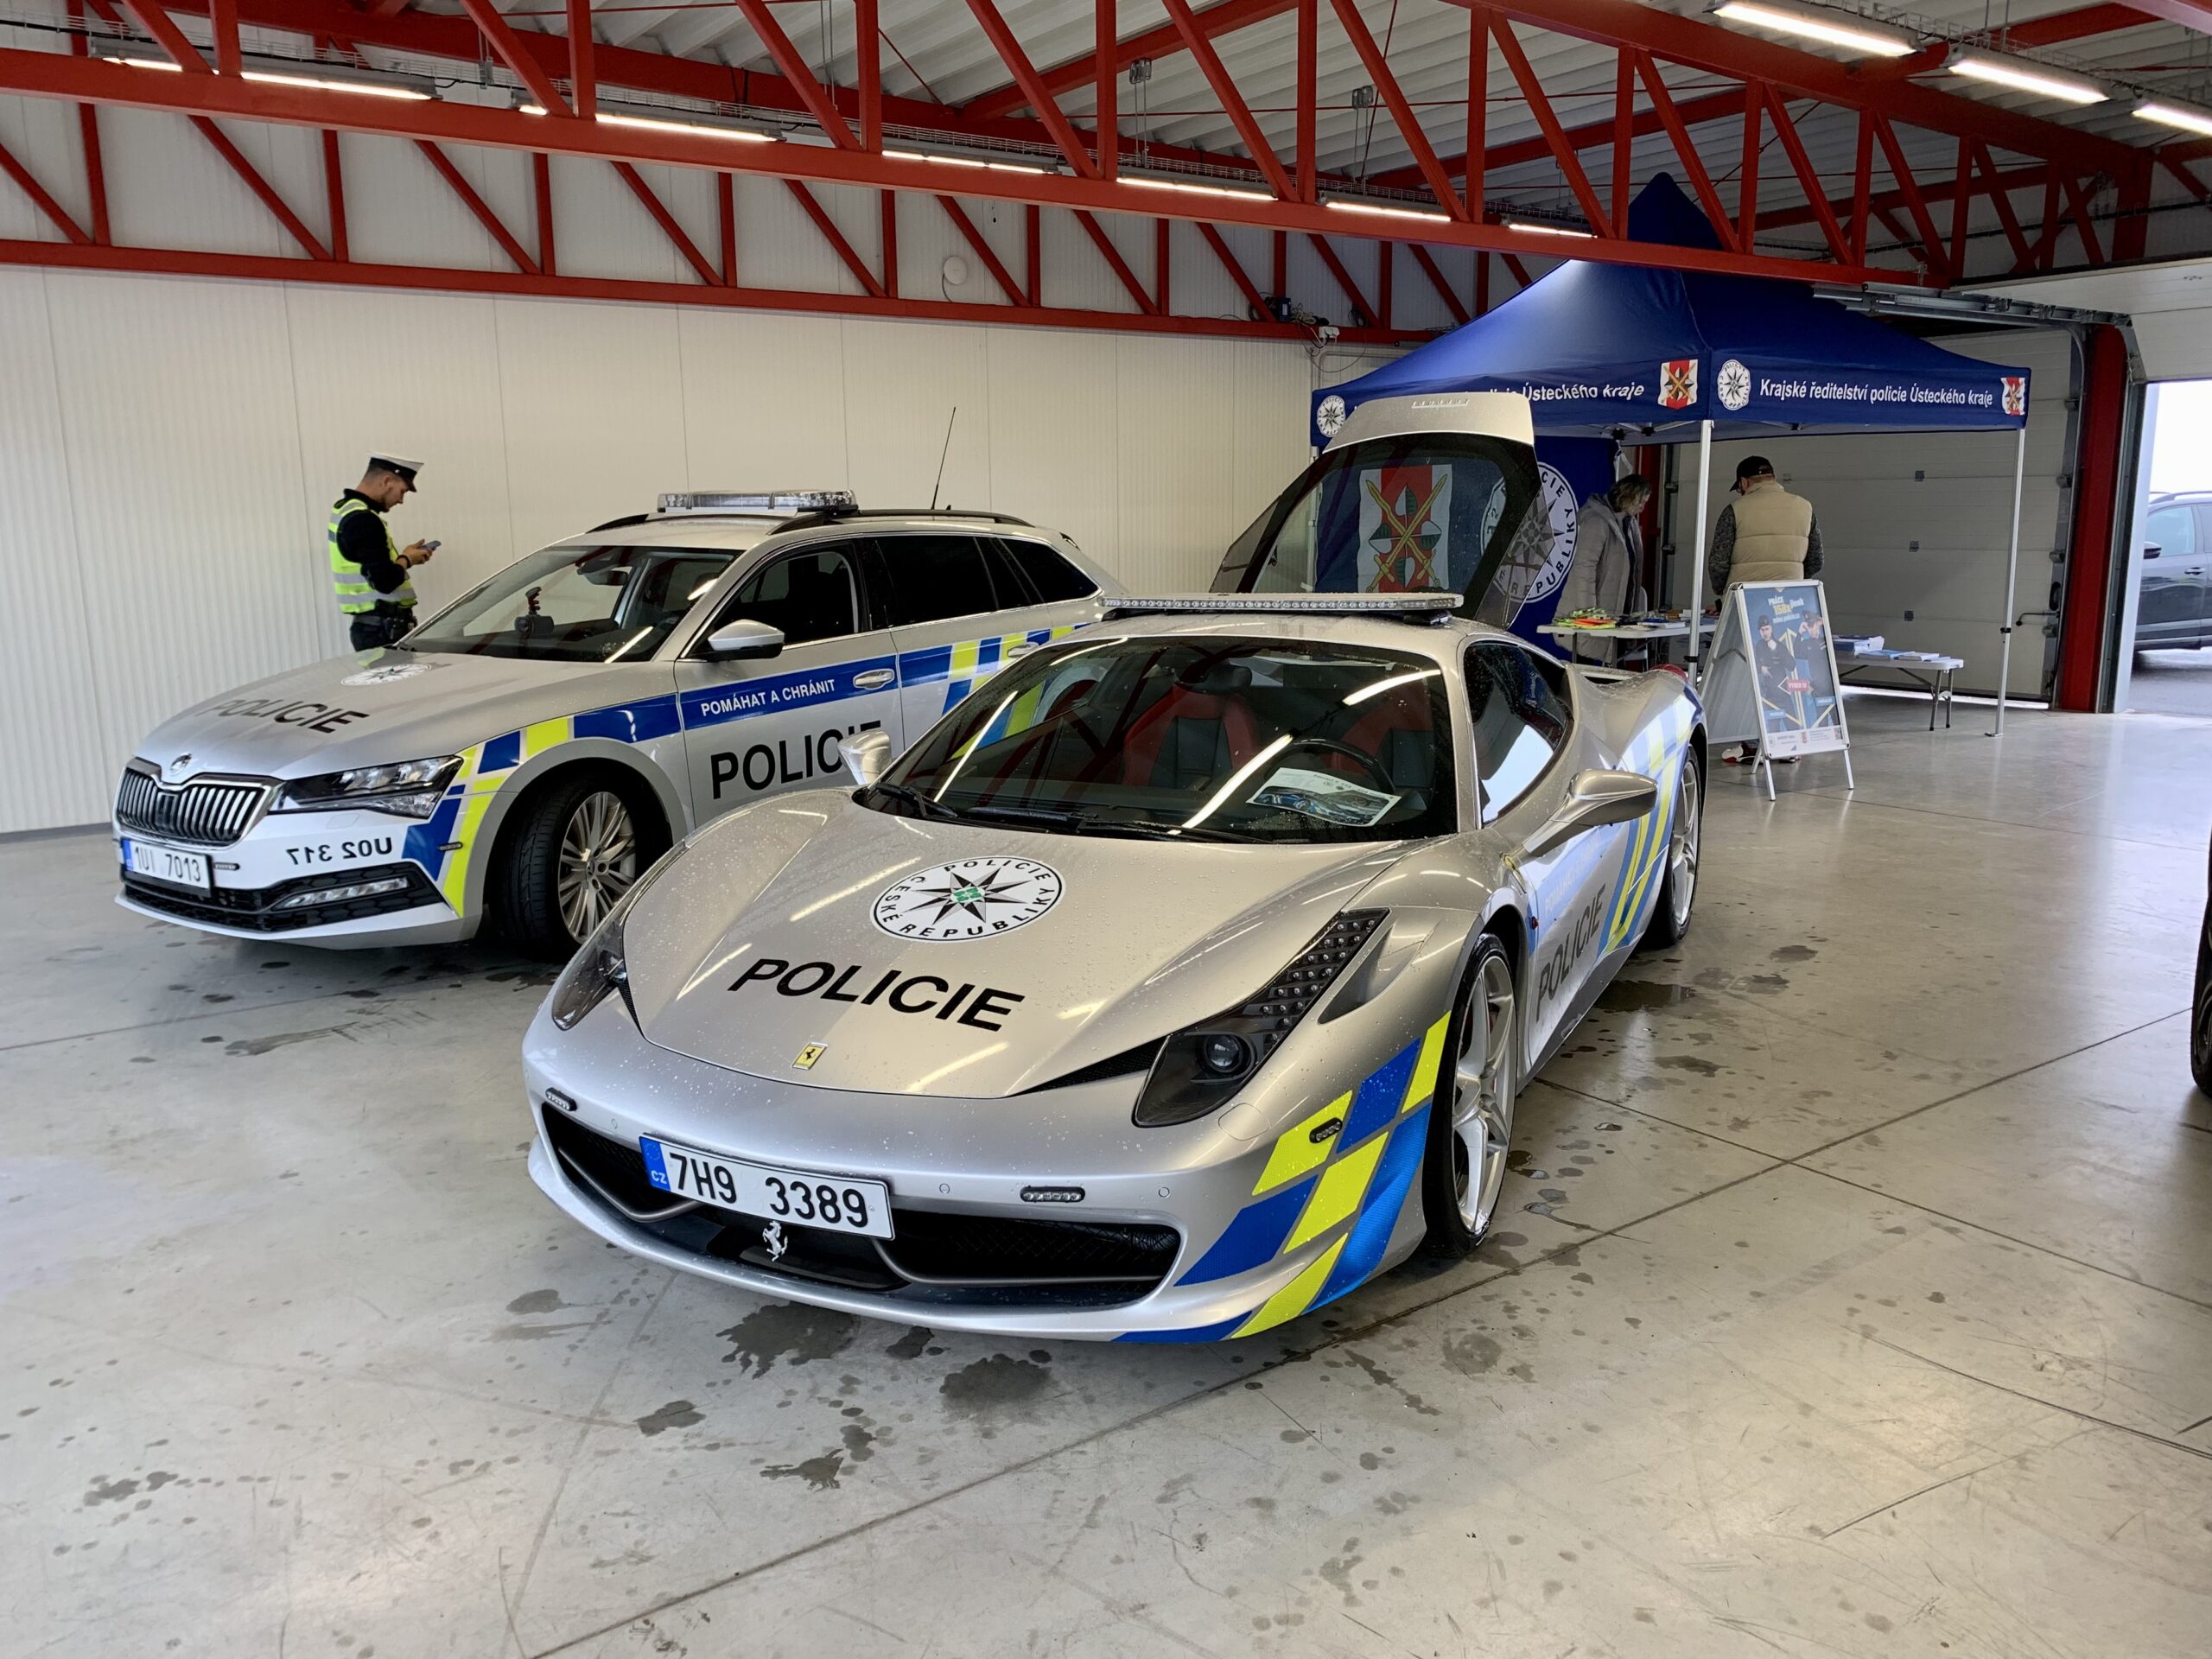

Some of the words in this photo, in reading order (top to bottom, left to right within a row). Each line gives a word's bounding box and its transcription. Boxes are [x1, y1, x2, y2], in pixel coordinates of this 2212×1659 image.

[1522, 381, 1598, 402] Ústeckého
[1603, 381, 1645, 401] kraje
[1759, 378, 1807, 401] Krajské
[1809, 381, 1868, 402] ředitelství
[1870, 386, 1907, 404] policie
[1910, 386, 1966, 405] Ústeckého
[1967, 389, 1993, 407] kraje
[194, 697, 371, 734] POLICIE
[701, 692, 766, 717] POMÁHAT
[771, 690, 780, 703] A
[782, 679, 835, 701] CHRÁNIT
[710, 720, 881, 800] POLIC
[165, 853, 200, 882] 7013
[944, 859, 1052, 881] POLICIE
[899, 887, 1056, 938] REPUBLIKY
[1535, 883, 1606, 1023] POLICIE
[727, 958, 1026, 1033] POLICIE
[651, 1170, 668, 1185] CZ
[669, 1152, 737, 1205] 7H9
[765, 1176, 869, 1228] 3389
